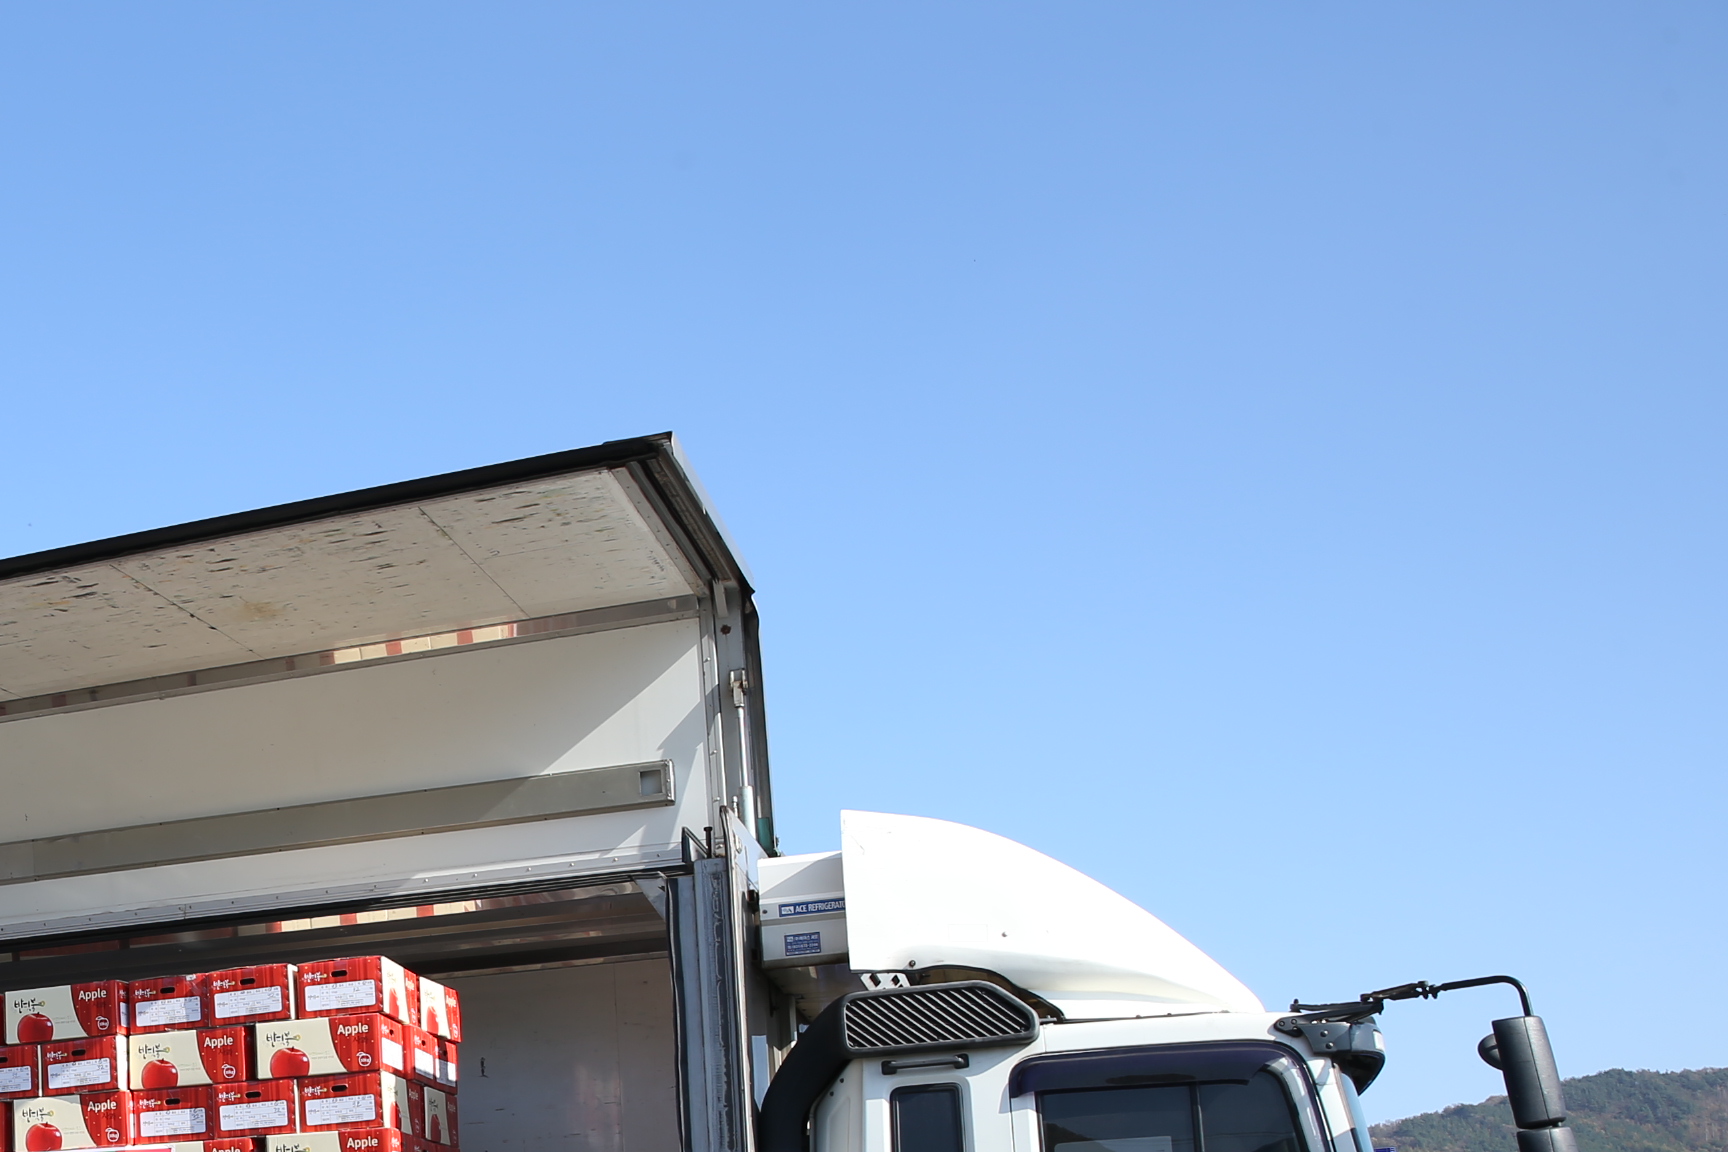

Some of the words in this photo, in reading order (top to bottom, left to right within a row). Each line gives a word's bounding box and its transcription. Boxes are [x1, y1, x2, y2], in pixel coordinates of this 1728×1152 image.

[795, 904, 807, 913] ACE
[78, 988, 107, 1000] Apple
[337, 1023, 369, 1036] Apple
[204, 1035, 233, 1048] Apple
[87, 1099, 117, 1112] Apple
[346, 1136, 379, 1151] Apple
